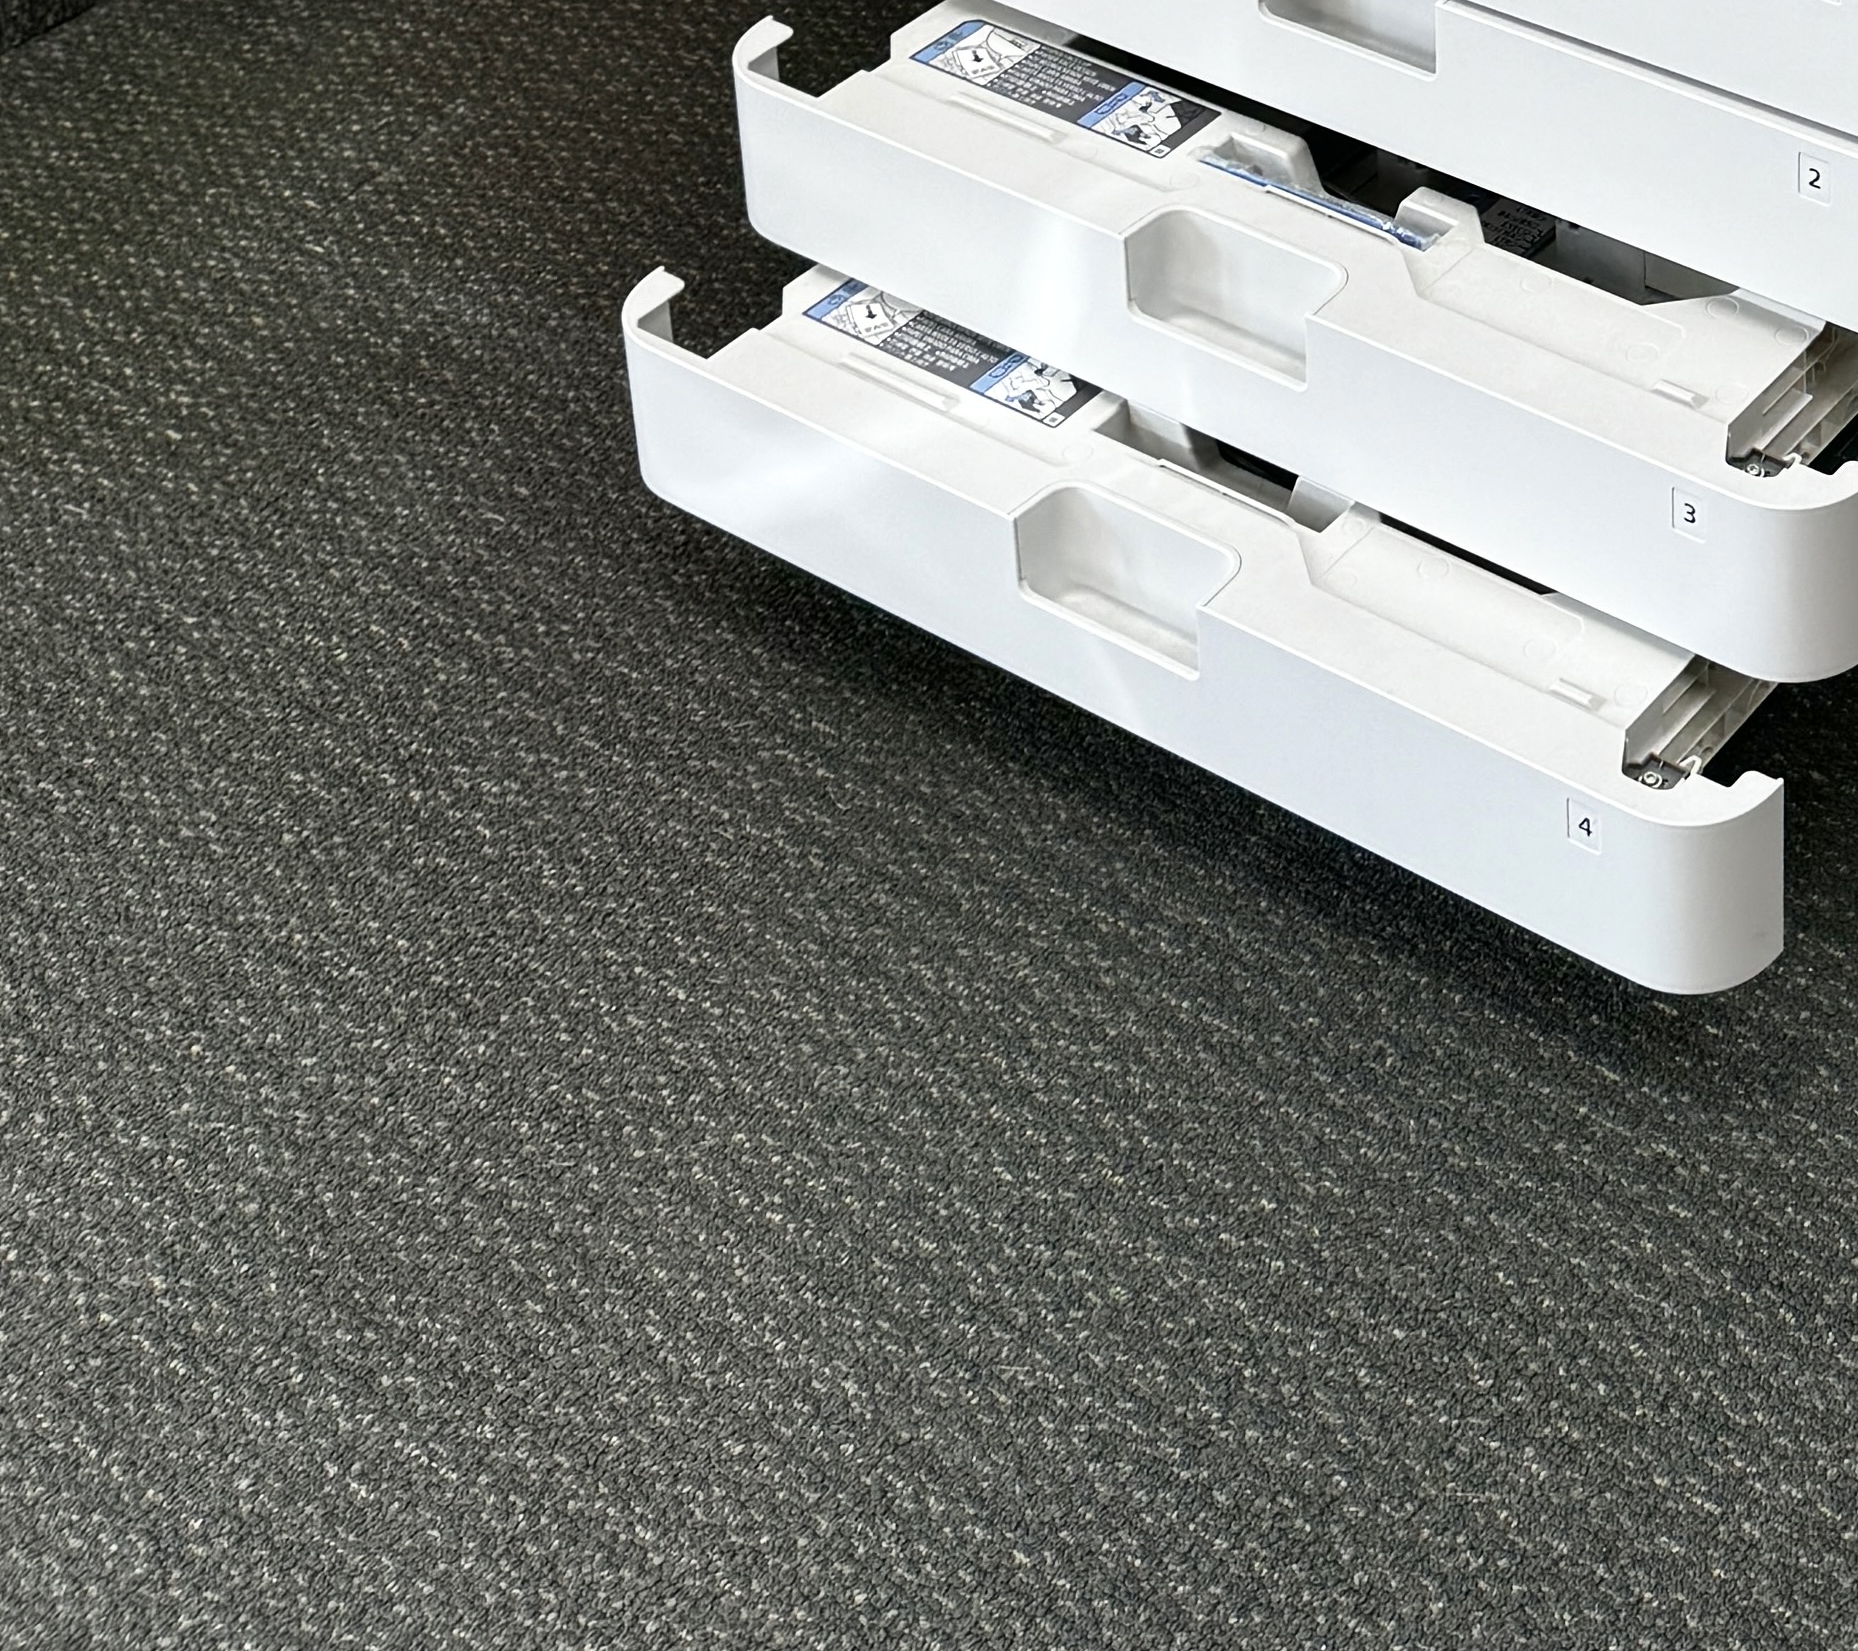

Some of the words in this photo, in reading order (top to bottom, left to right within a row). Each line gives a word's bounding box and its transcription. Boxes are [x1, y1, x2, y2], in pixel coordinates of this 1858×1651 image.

[1808, 167, 1822, 190] 2
[1683, 502, 1697, 524] 3
[1578, 816, 1593, 838] 4
